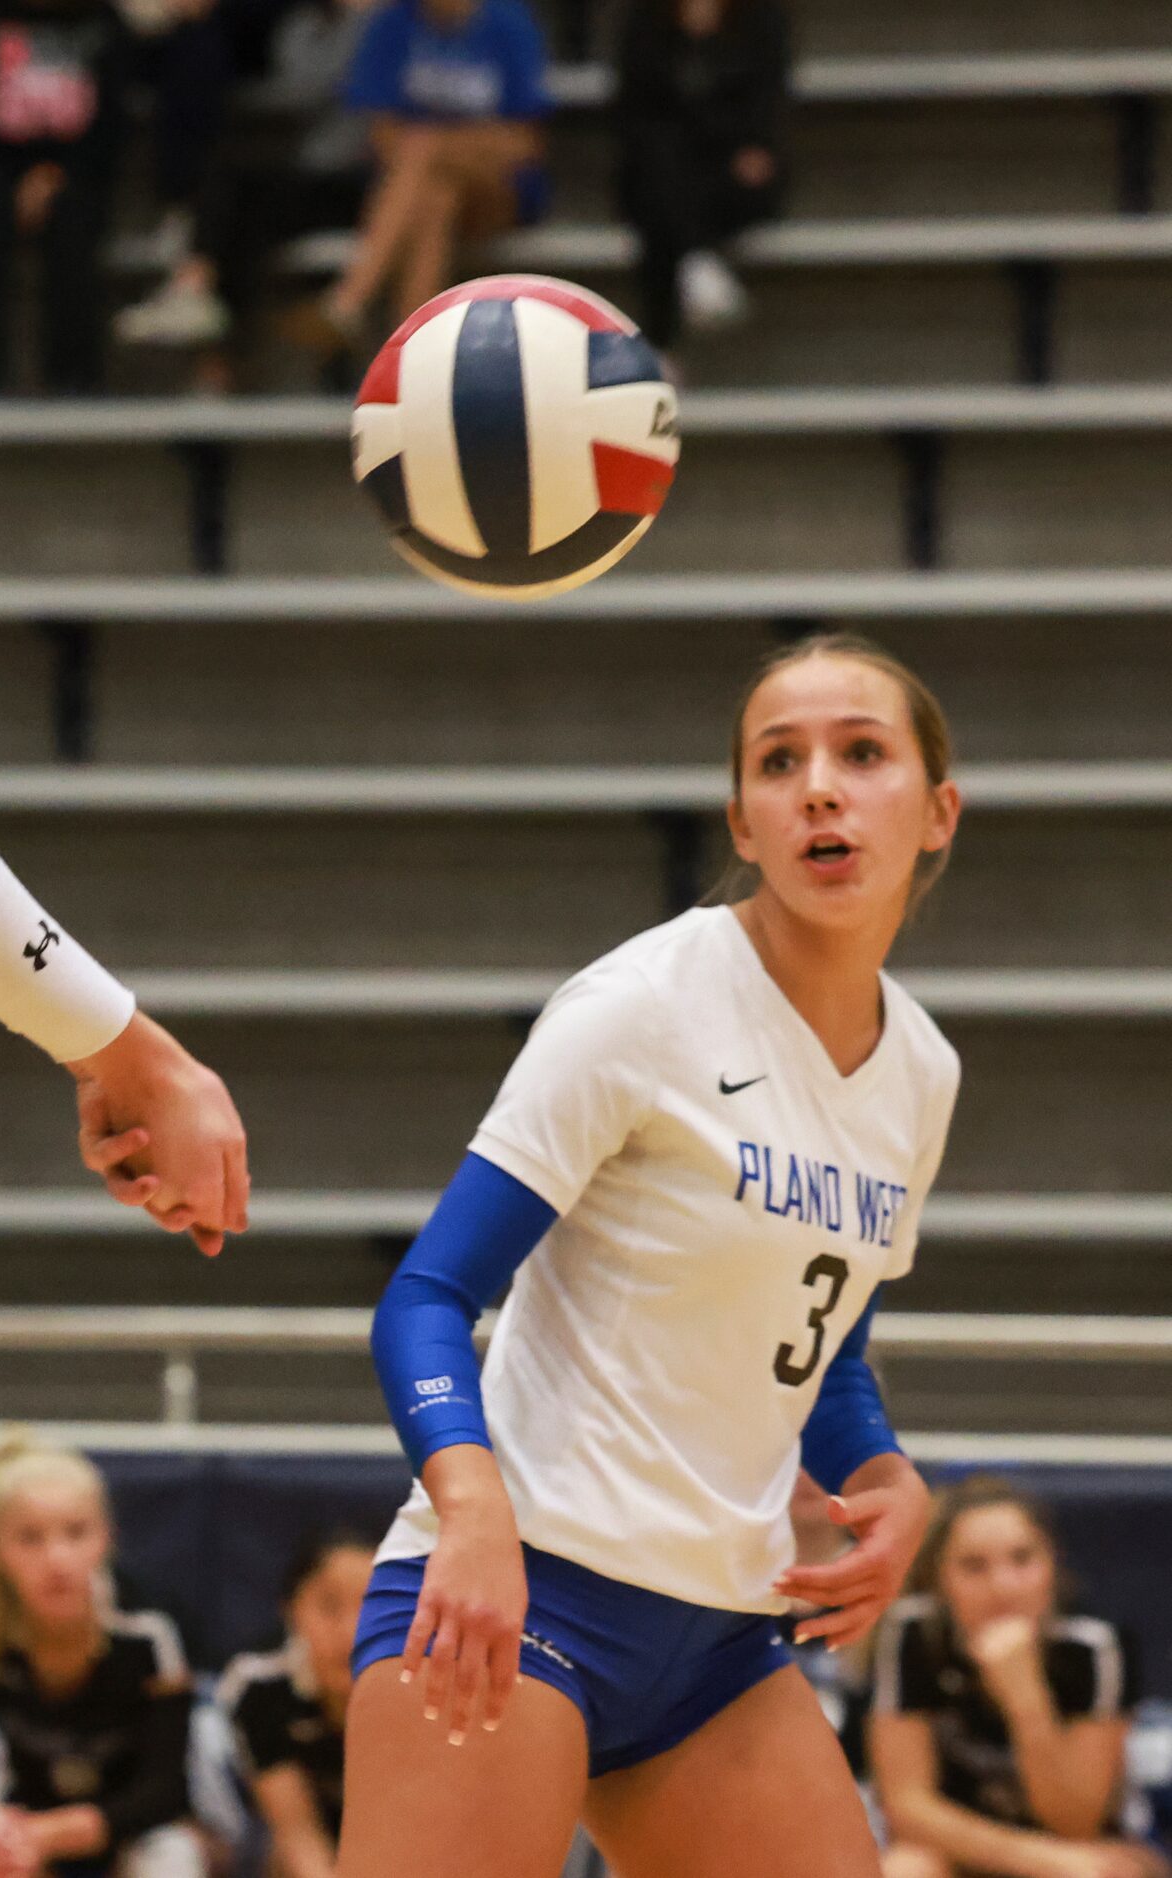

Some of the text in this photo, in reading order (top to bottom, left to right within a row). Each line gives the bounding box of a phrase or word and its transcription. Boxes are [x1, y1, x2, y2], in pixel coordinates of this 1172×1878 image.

[734, 1140, 907, 1247] PLANO WET
[773, 1253, 849, 1387] 3
